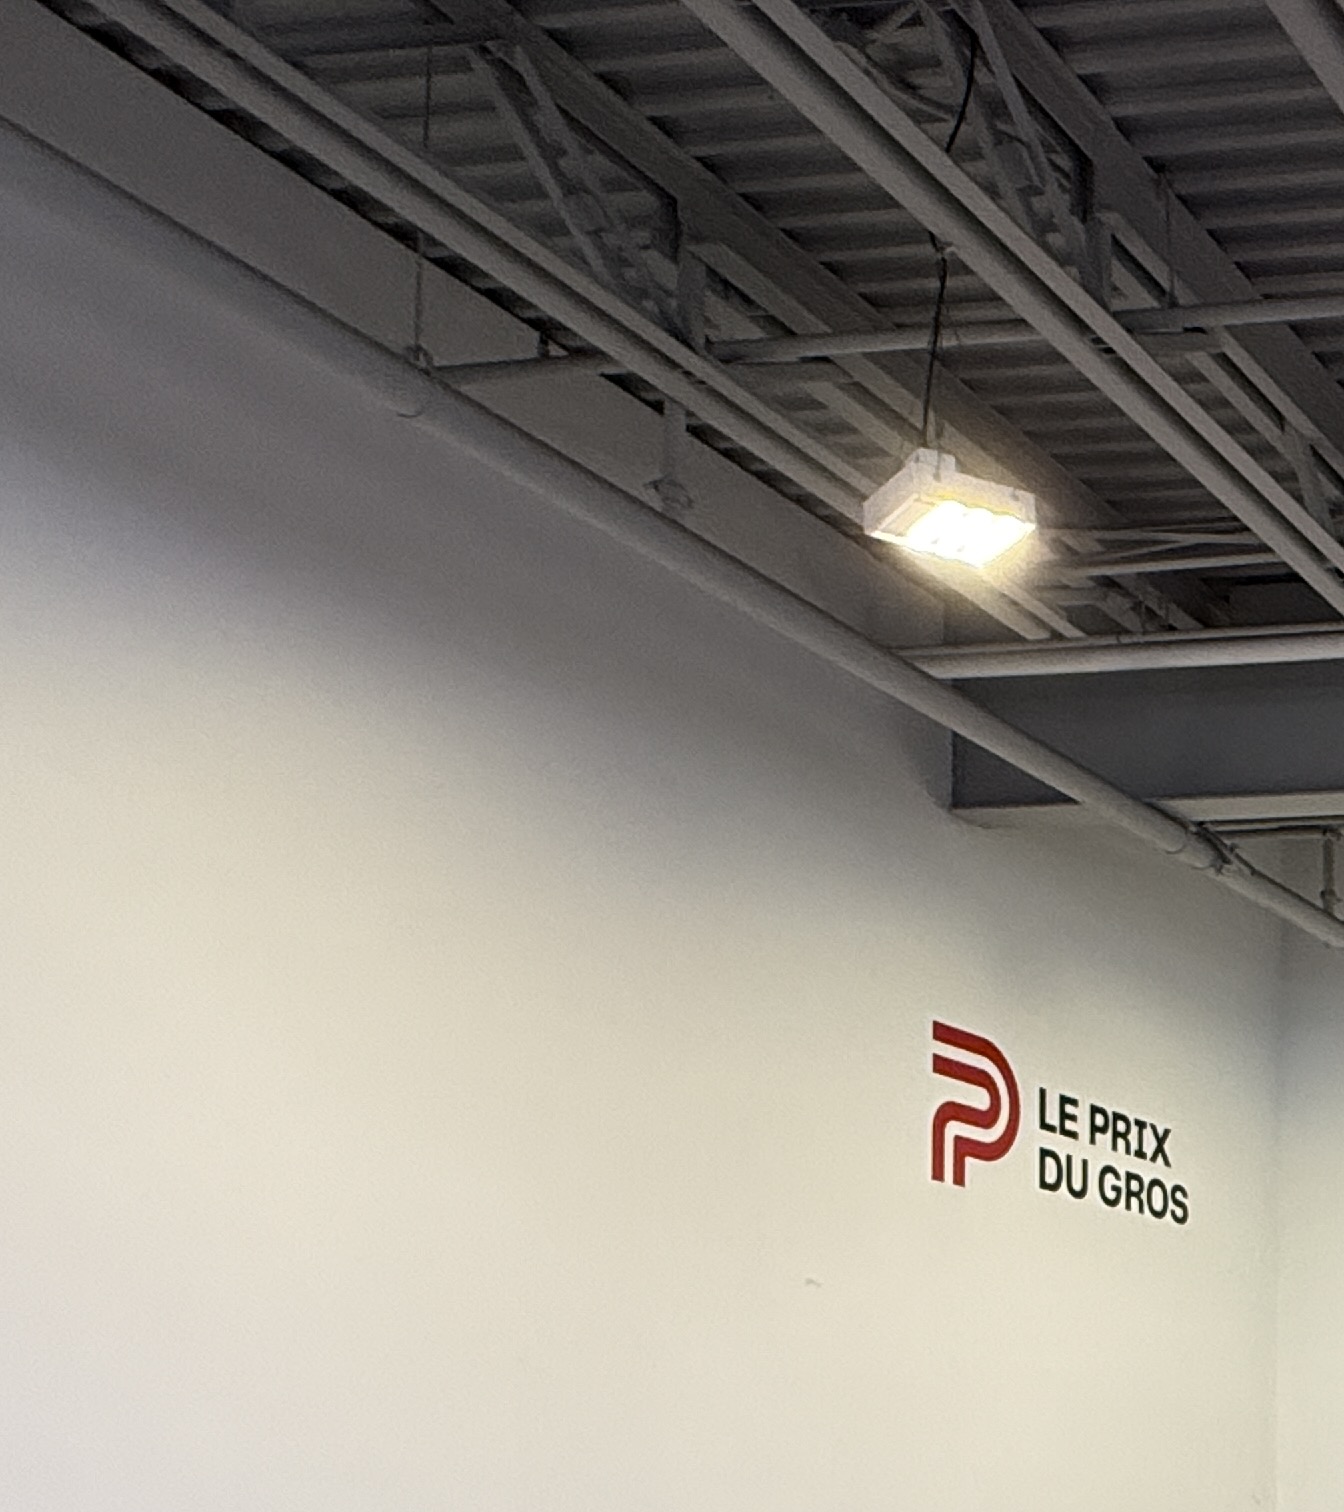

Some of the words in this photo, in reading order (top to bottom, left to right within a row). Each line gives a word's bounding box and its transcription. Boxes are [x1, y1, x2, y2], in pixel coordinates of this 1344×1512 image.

[1038, 1086, 1079, 1141] LE
[1089, 1103, 1172, 1168] PRIX
[1038, 1146, 1089, 1200] DU
[1098, 1164, 1190, 1225] GROS
